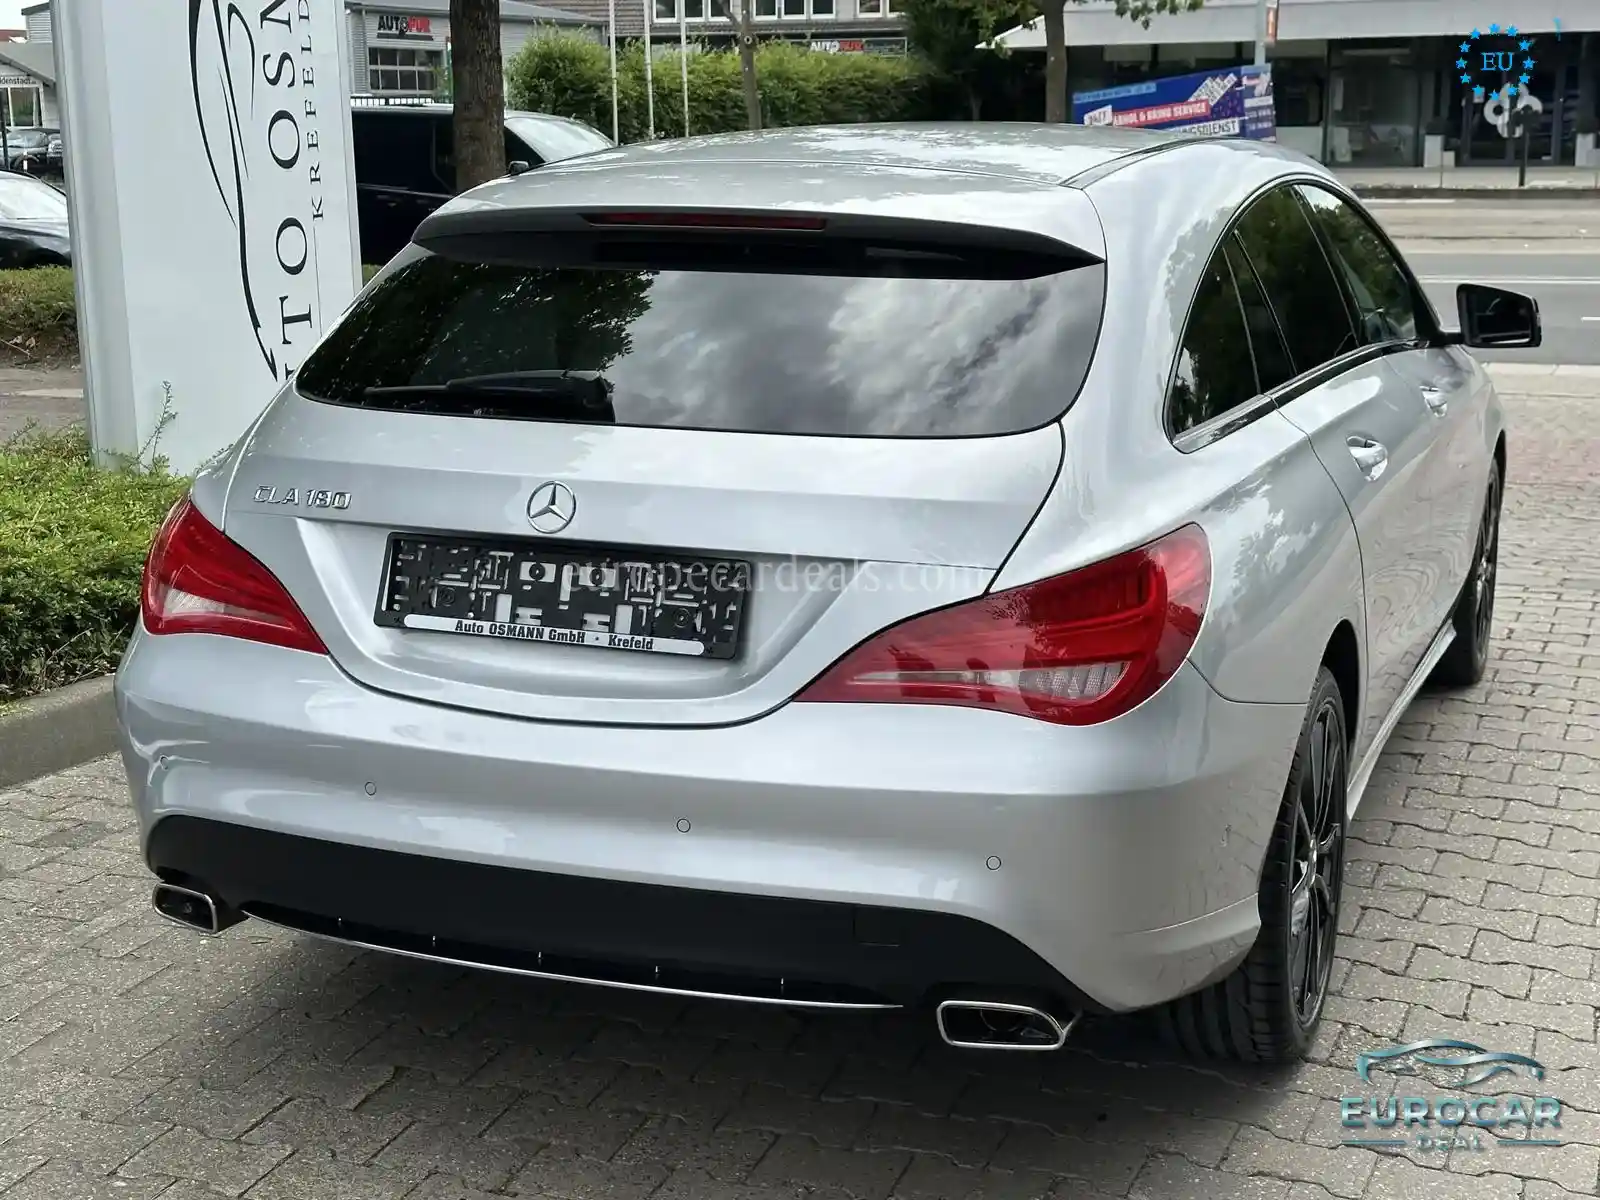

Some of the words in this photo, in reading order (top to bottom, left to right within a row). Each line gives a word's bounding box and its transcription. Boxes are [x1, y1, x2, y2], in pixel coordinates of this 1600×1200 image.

[298, 0, 324, 221] KREFELD
[254, 485, 299, 505] CLA
[306, 489, 352, 509] 180
[455, 619, 484, 635] Auto
[488, 622, 544, 641] OSMANN
[548, 629, 586, 644] GmbH
[608, 633, 654, 650] Krefeld
